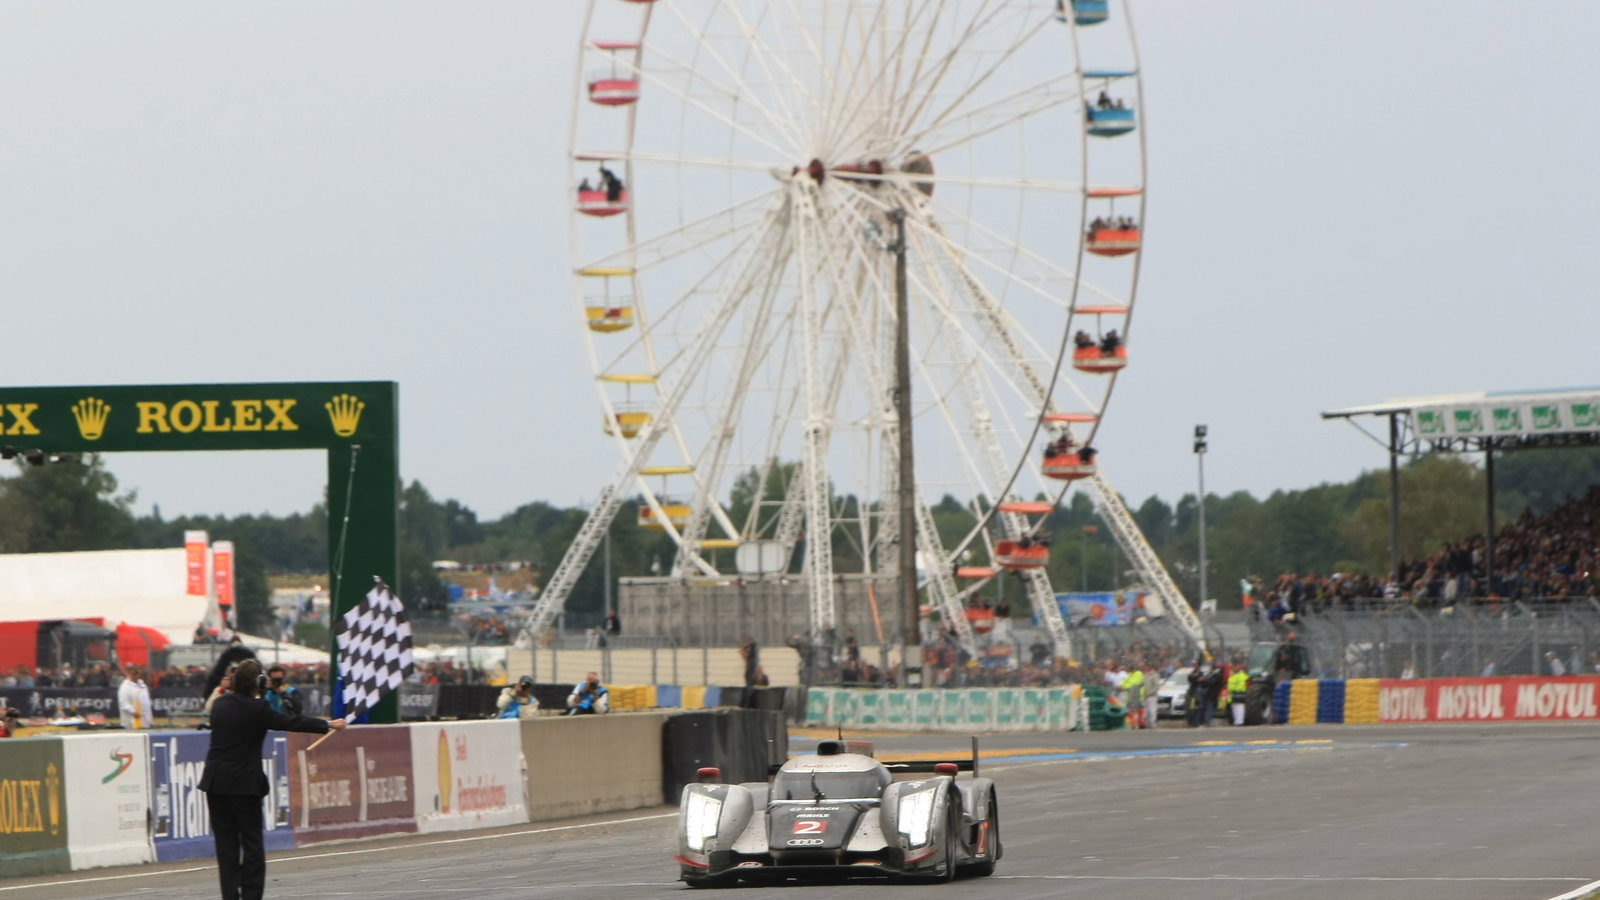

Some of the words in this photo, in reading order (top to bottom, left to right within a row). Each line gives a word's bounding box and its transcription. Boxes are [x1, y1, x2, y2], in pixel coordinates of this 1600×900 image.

[136, 400, 299, 433] ROLEX
[1380, 688, 1427, 720] MOTUL
[1437, 684, 1504, 718] MOTUL
[1515, 683, 1597, 717] MOTUL
[794, 821, 822, 835] 2
